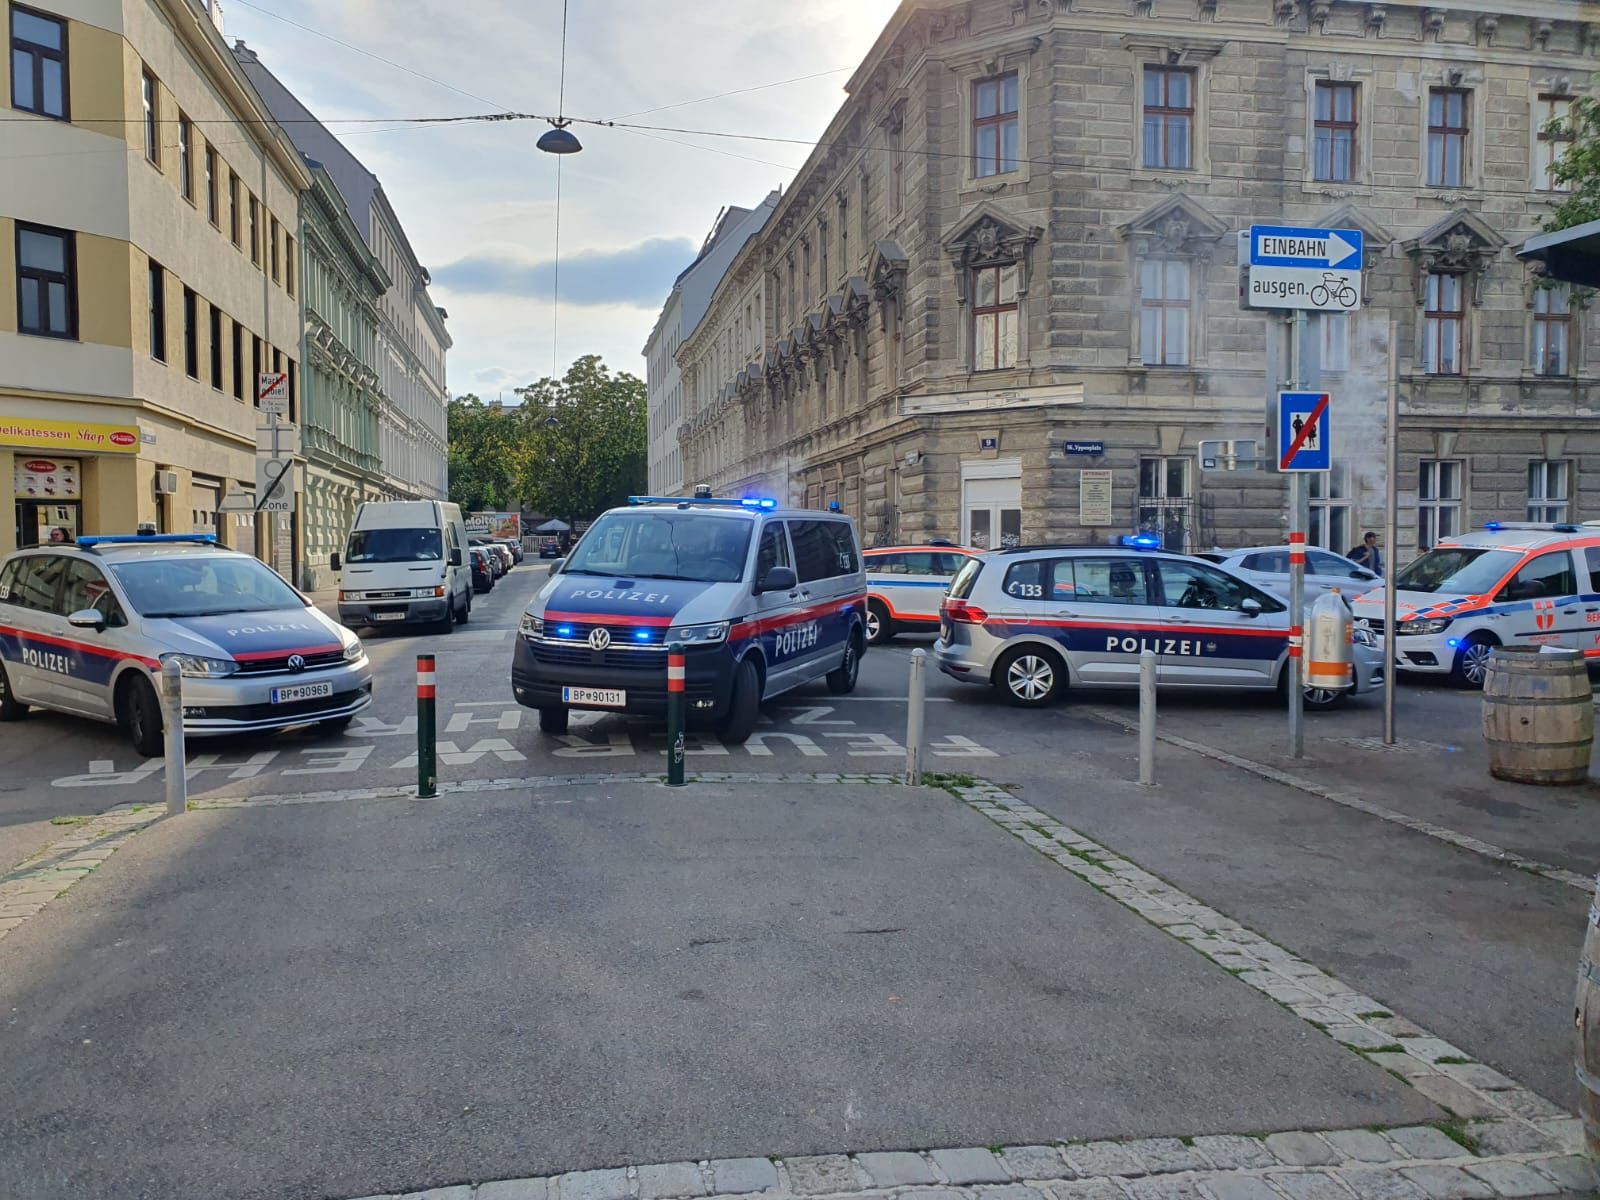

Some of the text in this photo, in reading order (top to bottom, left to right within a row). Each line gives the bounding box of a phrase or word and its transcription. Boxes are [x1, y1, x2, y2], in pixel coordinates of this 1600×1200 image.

[1263, 238, 1327, 257] EINBAHN
[1253, 280, 1310, 298] ausgen.
[0, 425, 71, 439] elikatessen
[76, 429, 105, 444] Shop
[985, 439, 992, 447] 9
[262, 499, 288, 510] Zone
[570, 590, 670, 604] POLIZEI
[1019, 583, 1042, 597] 133
[227, 624, 309, 637] POLIZEI
[775, 624, 818, 657] POLIZEI
[1106, 636, 1202, 656] POLIZEI
[22, 647, 69, 675] POLIZEI
[299, 684, 329, 698] 90969
[592, 691, 621, 702] 90131
